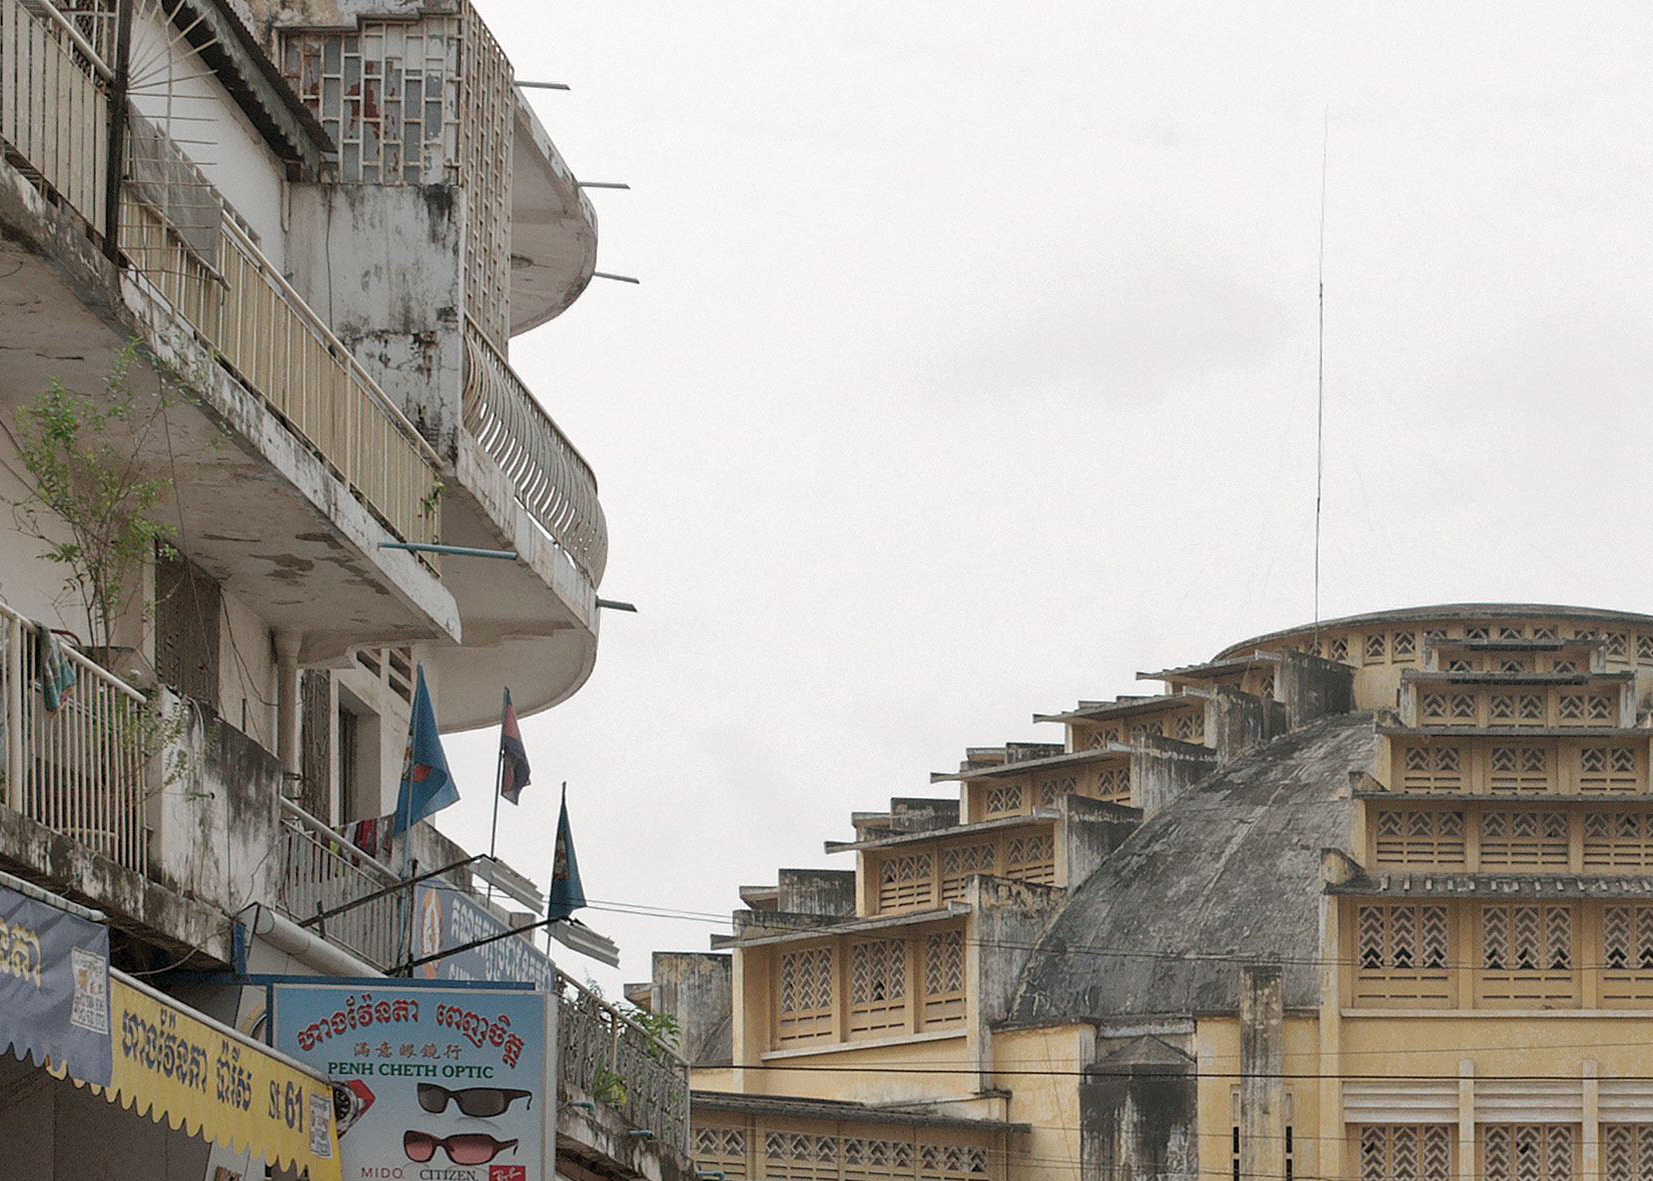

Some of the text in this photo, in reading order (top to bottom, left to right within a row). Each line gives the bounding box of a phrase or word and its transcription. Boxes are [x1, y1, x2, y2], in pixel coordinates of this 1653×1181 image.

[296, 993, 419, 1051] ហាងវ៉ែនតា
[328, 1062, 494, 1079] PENH CHETH OPTIC
[361, 1167, 404, 1180] MIDO
